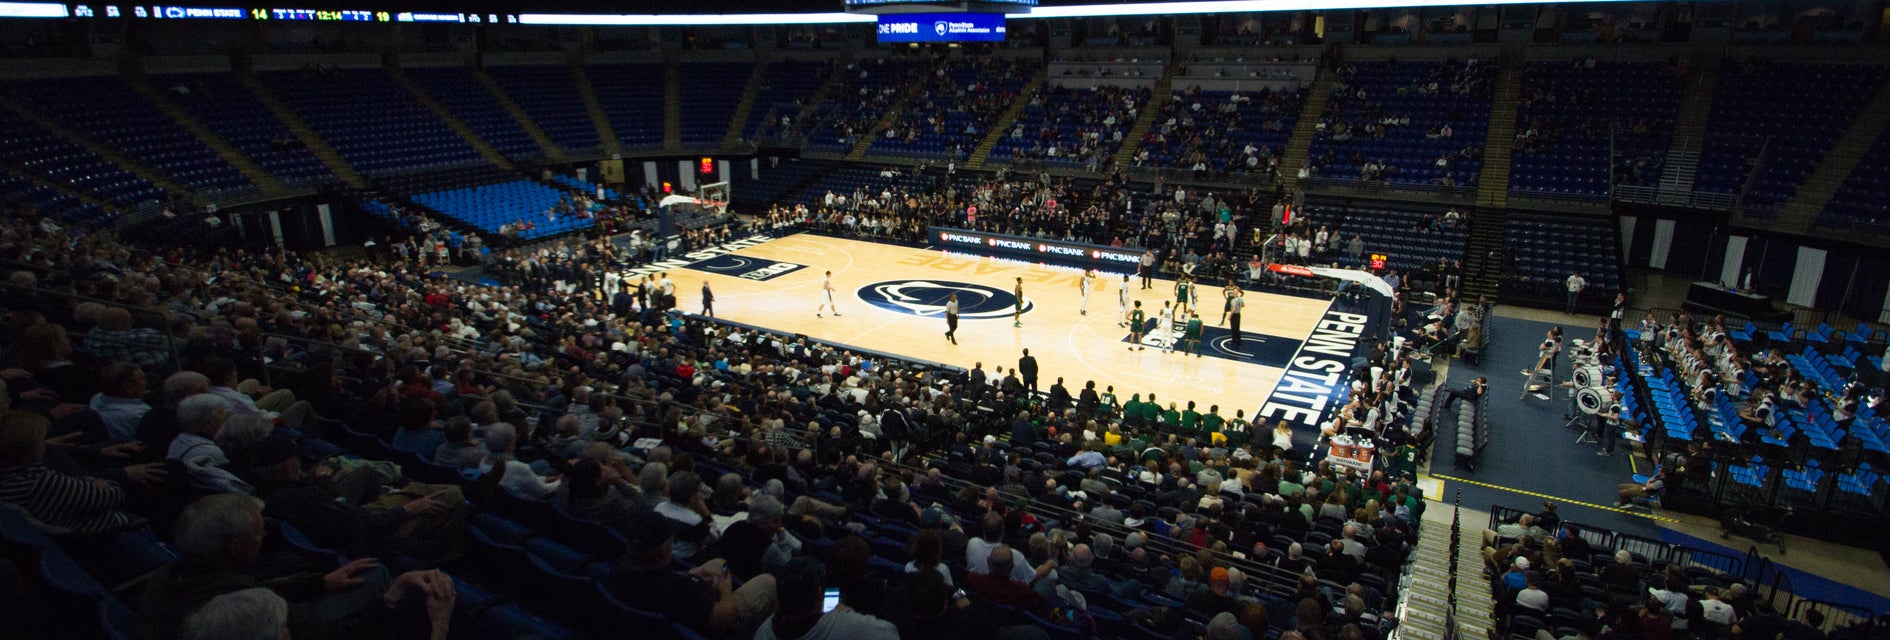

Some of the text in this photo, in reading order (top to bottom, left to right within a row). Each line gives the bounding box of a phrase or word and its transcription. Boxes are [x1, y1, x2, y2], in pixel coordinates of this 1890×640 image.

[186, 8, 241, 17] PENN STATE
[252, 8, 268, 20] 14
[316, 10, 343, 21] 12:14
[376, 11, 390, 22] 19
[879, 22, 918, 34] ONE PRIDE
[685, 235, 777, 260] STATE
[1260, 310, 1368, 426] PENN STATE
[1233, 422, 1245, 433] 14
[1407, 451, 1415, 462] 3
